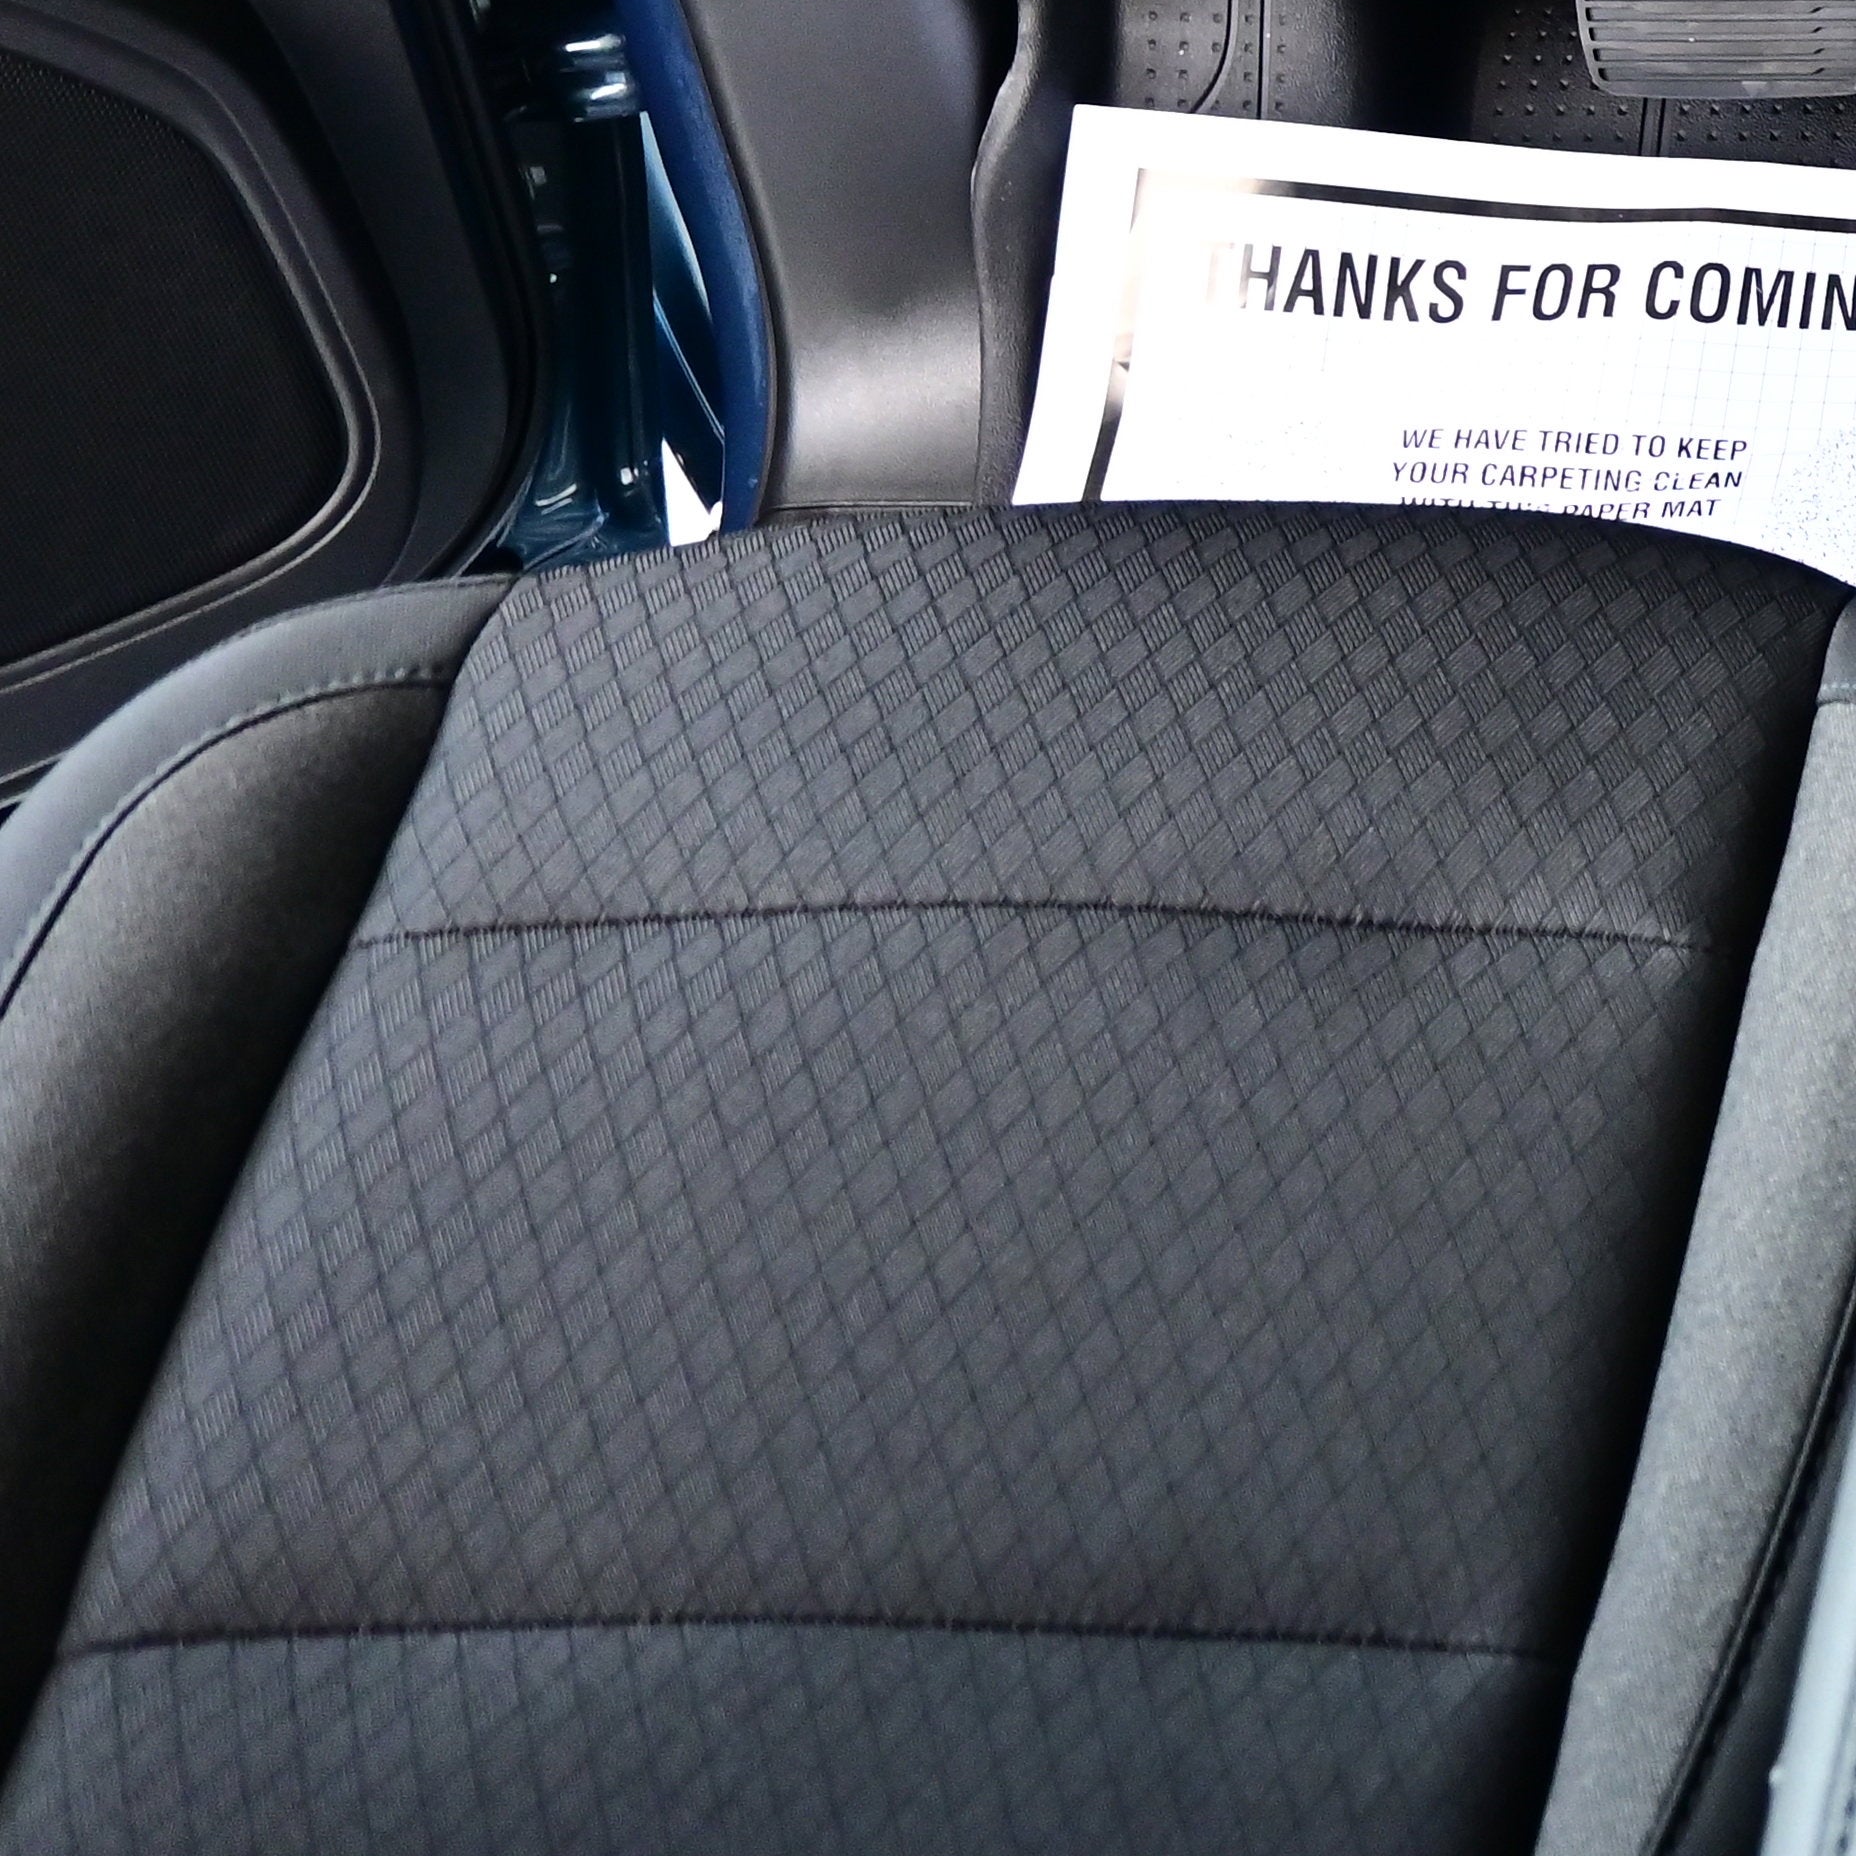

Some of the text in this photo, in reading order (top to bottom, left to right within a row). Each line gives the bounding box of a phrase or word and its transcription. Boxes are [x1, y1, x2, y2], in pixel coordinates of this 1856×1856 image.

[1491, 262, 1621, 321] FOR
[1402, 428, 1748, 462] WE HAVE TRIED TO KEEP
[1392, 461, 1743, 493] YOUR CARPETING CLEAN
[1661, 499, 1722, 519] MAT
